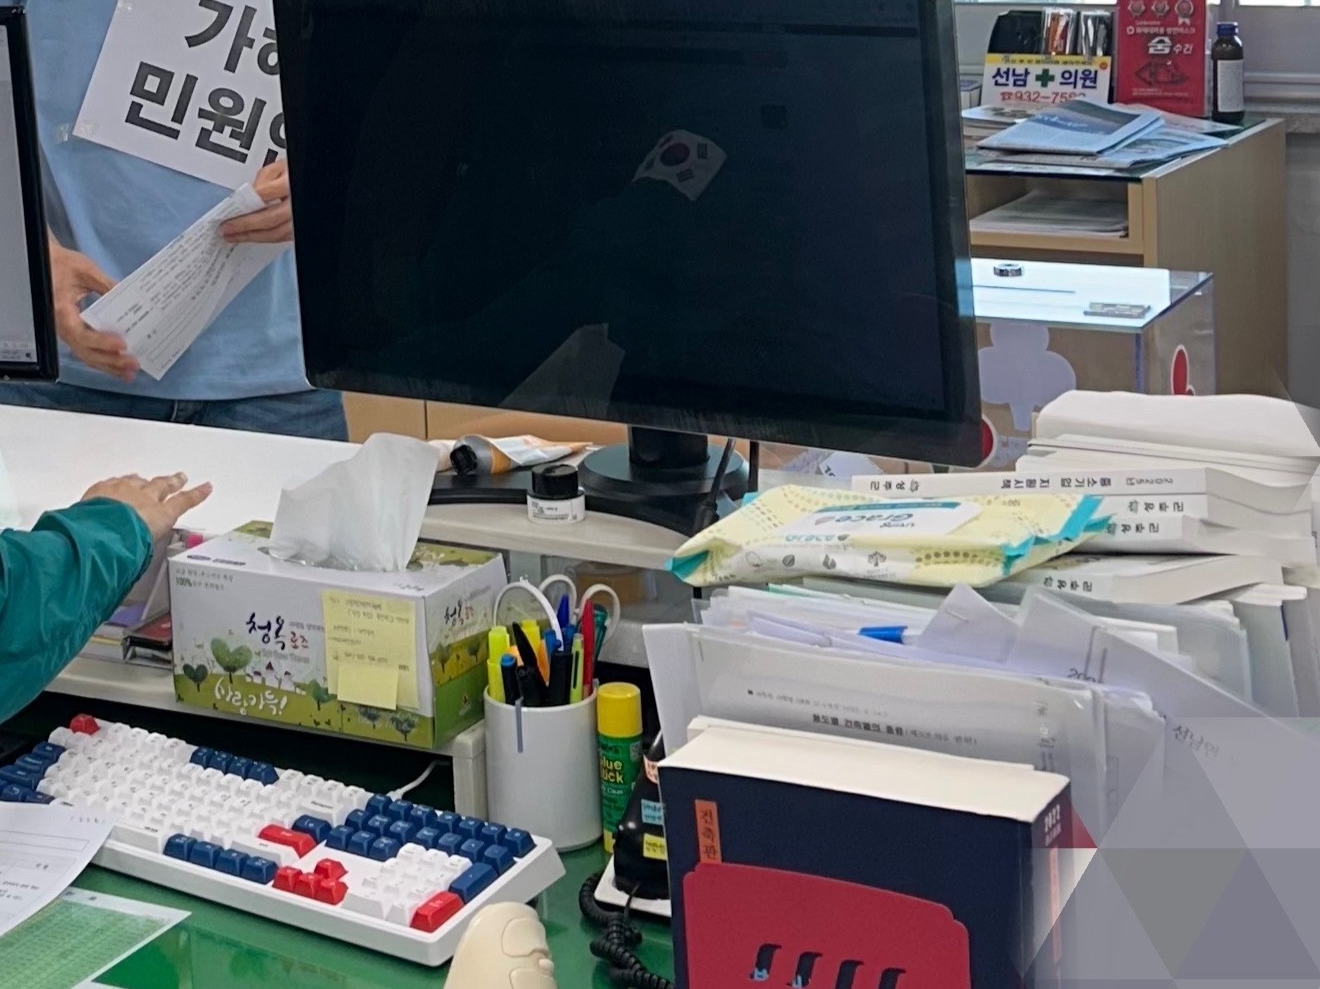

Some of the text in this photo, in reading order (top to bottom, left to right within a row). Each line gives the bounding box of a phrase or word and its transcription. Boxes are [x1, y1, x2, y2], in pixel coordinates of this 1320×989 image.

[992, 67, 1098, 89] 선남 의원
[835, 513, 913, 523] Grace
[246, 612, 287, 651] 청옥
[214, 677, 288, 716] 사랑가득!
